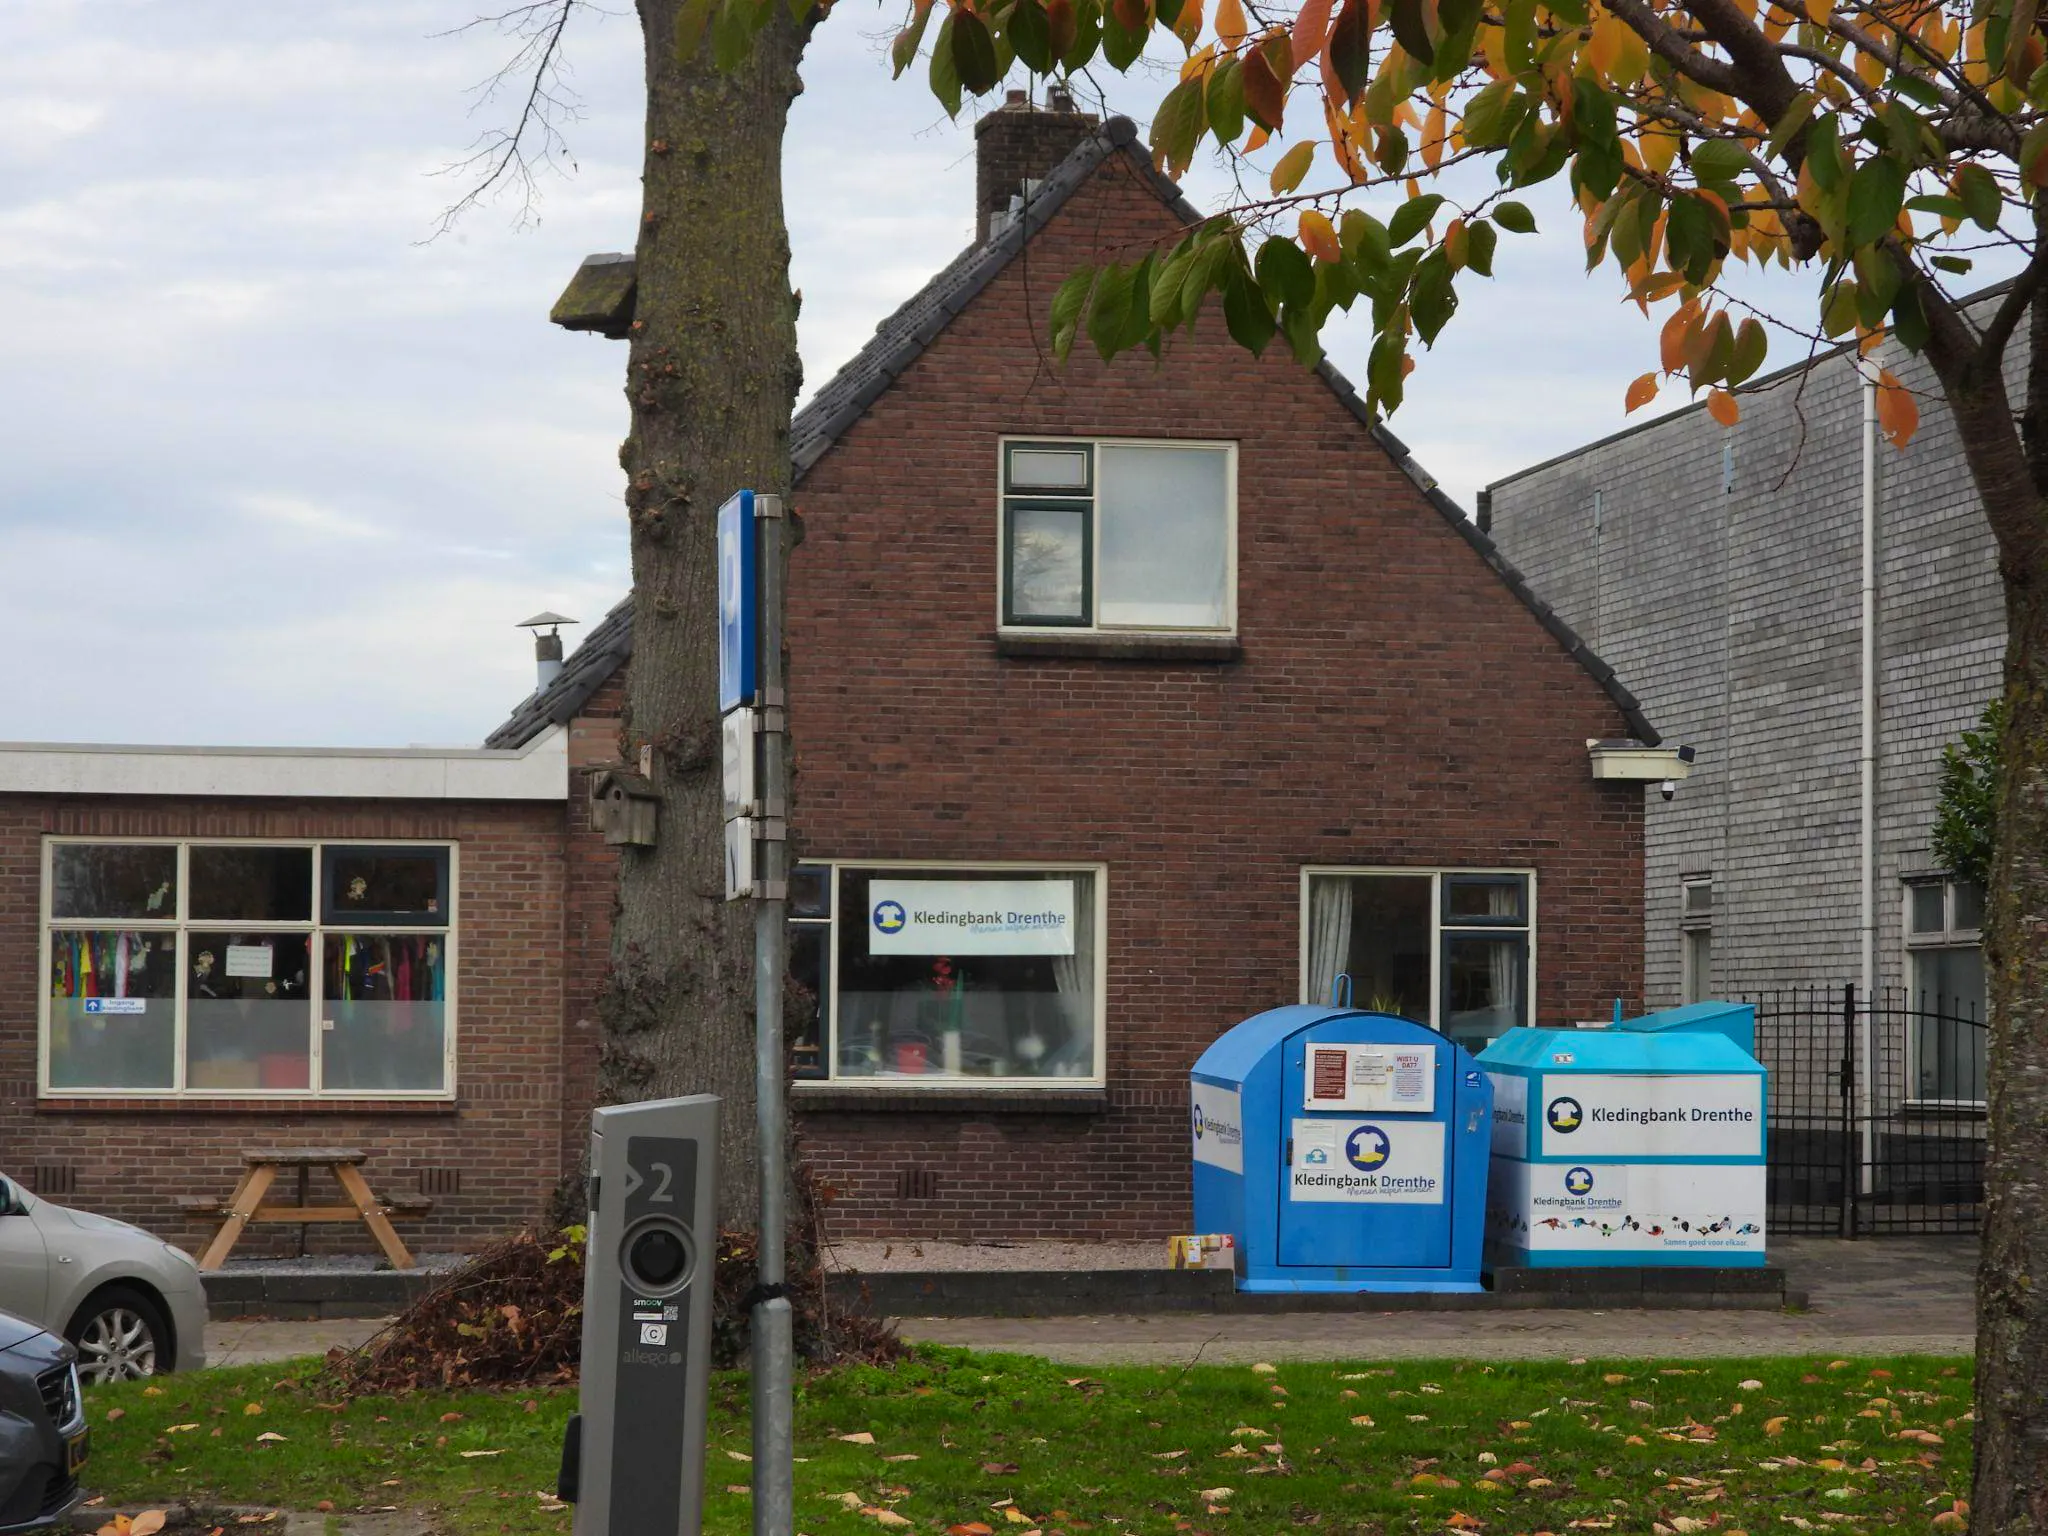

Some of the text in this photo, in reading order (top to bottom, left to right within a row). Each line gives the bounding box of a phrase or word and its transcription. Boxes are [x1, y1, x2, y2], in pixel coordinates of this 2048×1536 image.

[914, 910, 1066, 927] Kledingbank Drenthe
[1396, 1055, 1419, 1063] WIST U
[1591, 1107, 1753, 1125] Kledingbank Drenthe
[1204, 1117, 1227, 1136] Kledingbank
[649, 1162, 673, 1202] 2
[1294, 1173, 1436, 1189] Kledingbank Drenthe
[1533, 1196, 1622, 1206] Kledingbank Drenthe
[1688, 1239, 1706, 1247] goed
[649, 1329, 658, 1339] C
[622, 1347, 668, 1367] allego
